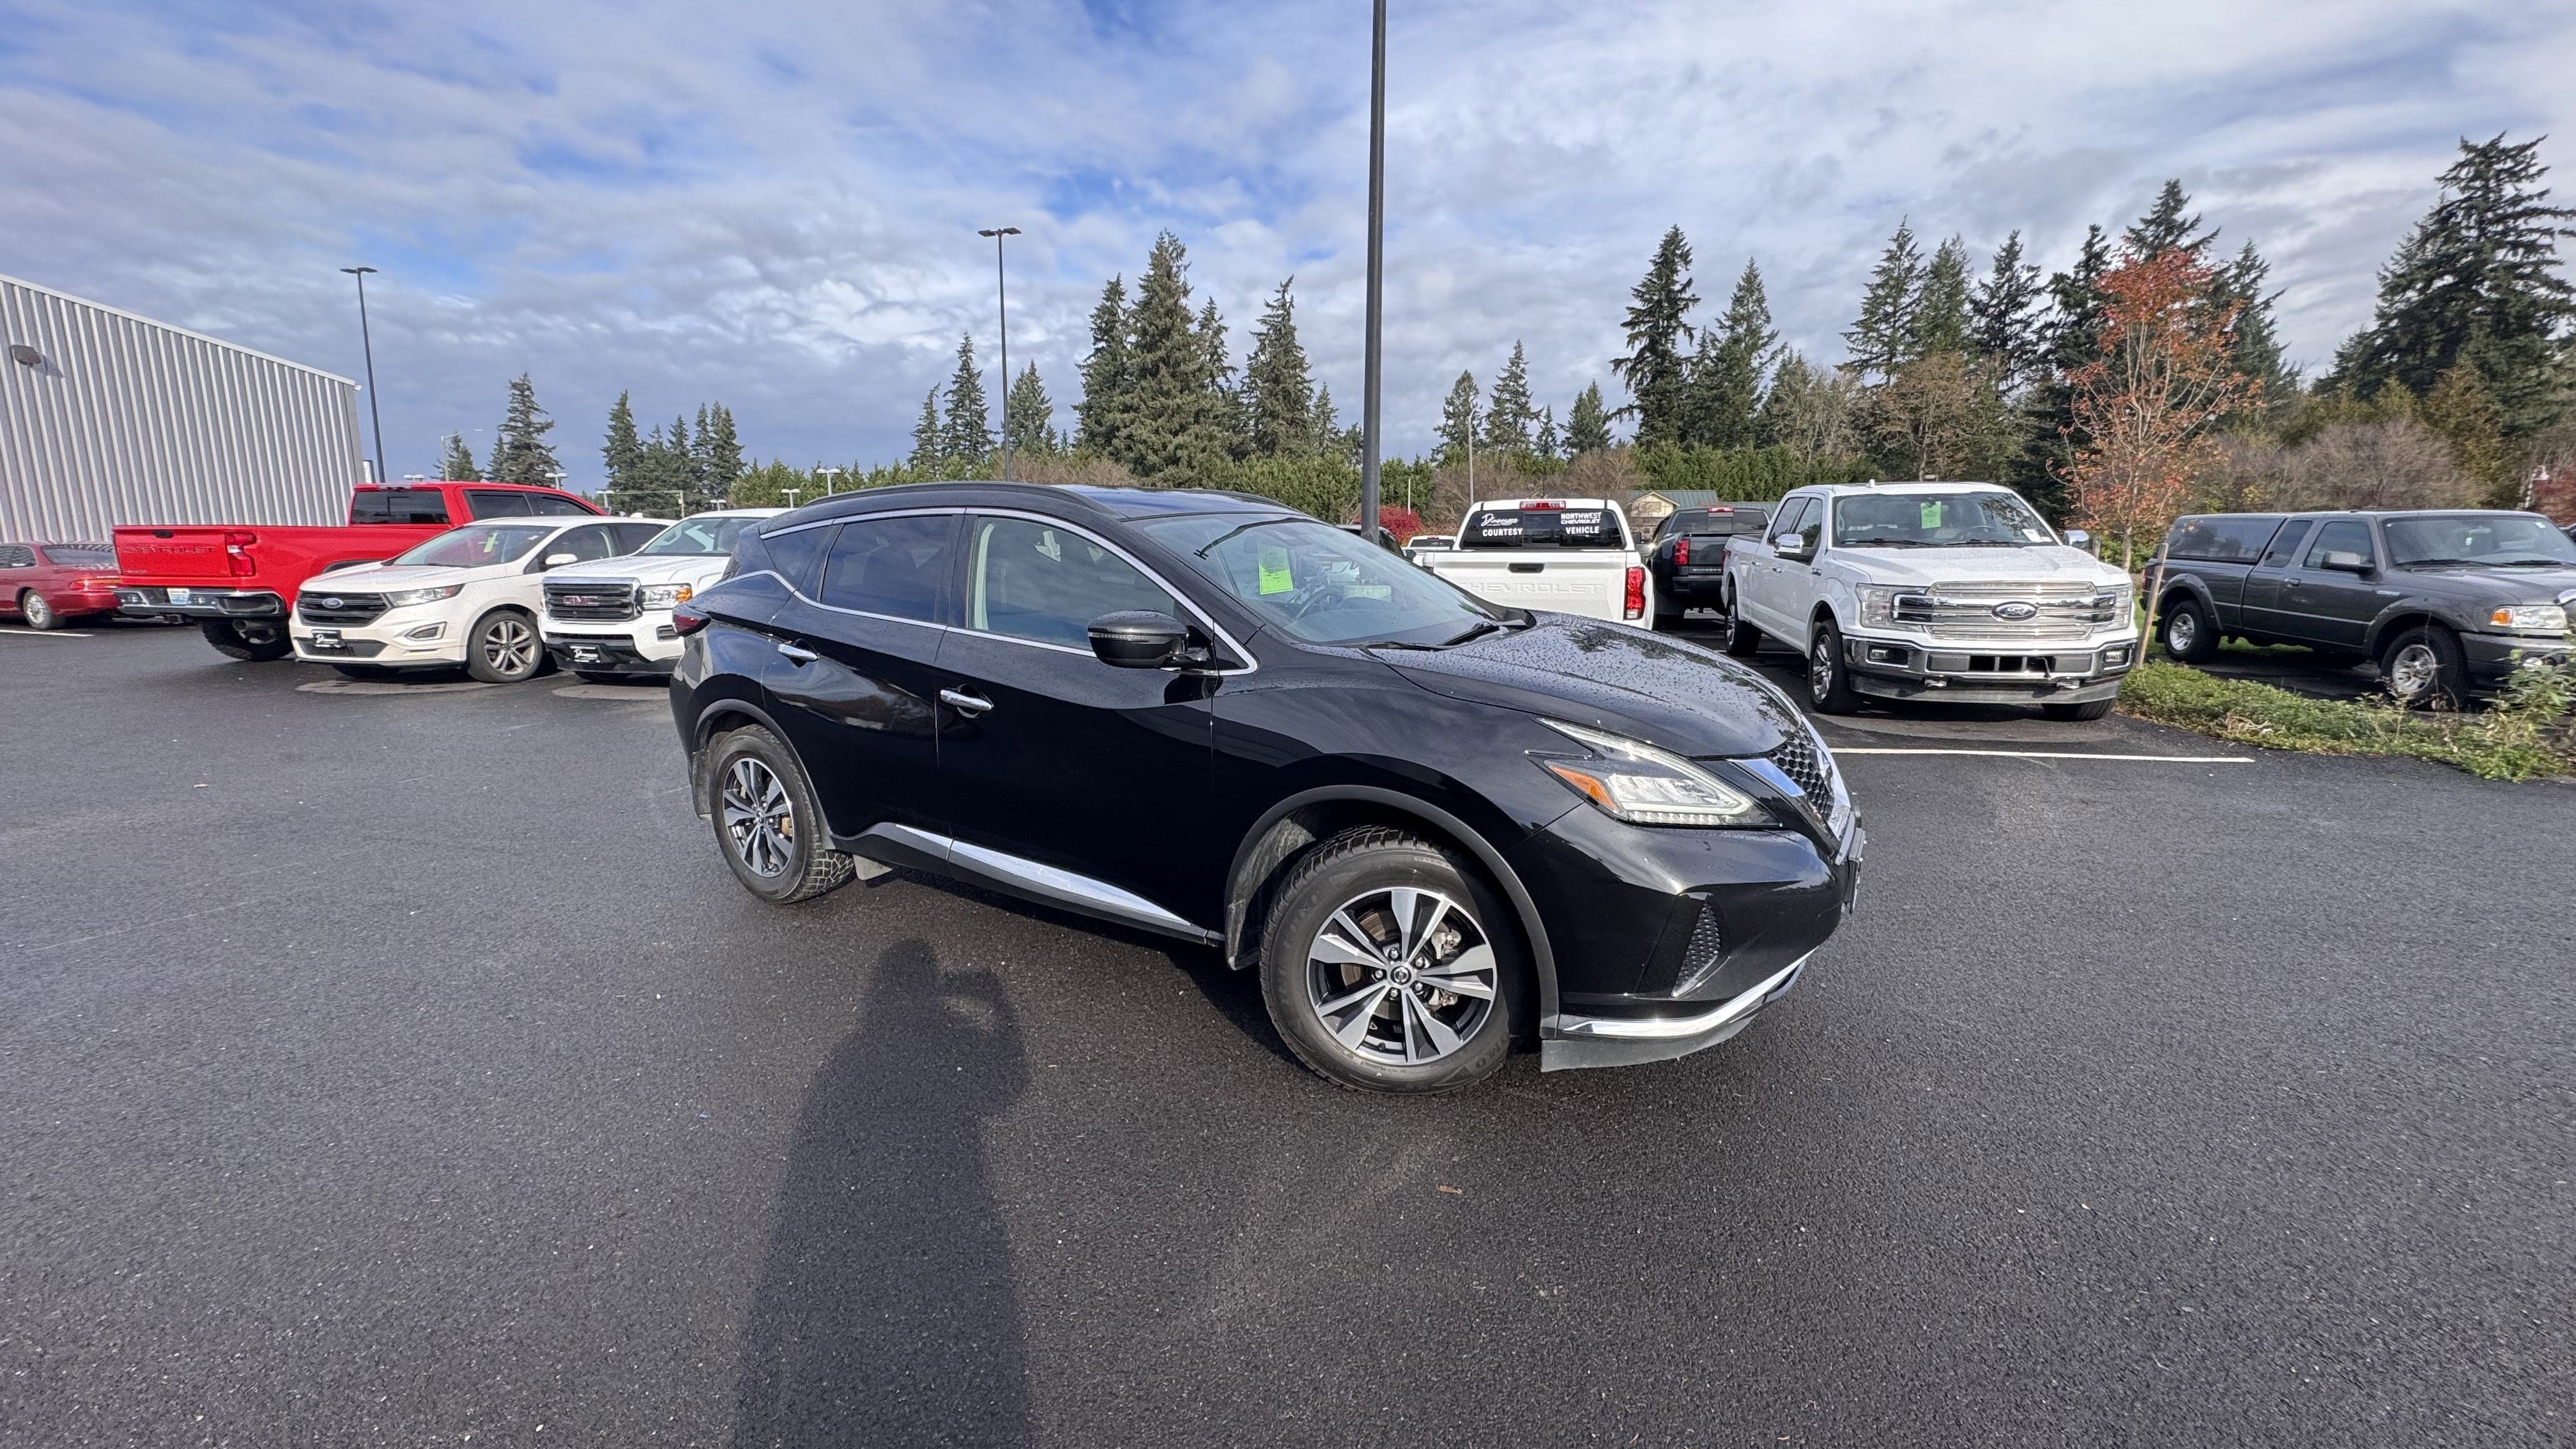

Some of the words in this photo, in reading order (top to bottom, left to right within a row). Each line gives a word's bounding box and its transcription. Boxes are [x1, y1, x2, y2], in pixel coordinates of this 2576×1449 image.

[1561, 512, 1602, 520] NORTHWEST
[1482, 527, 1524, 537] COURTESY
[1565, 525, 1600, 535] VEHICLE
[562, 595, 600, 606] GMC
